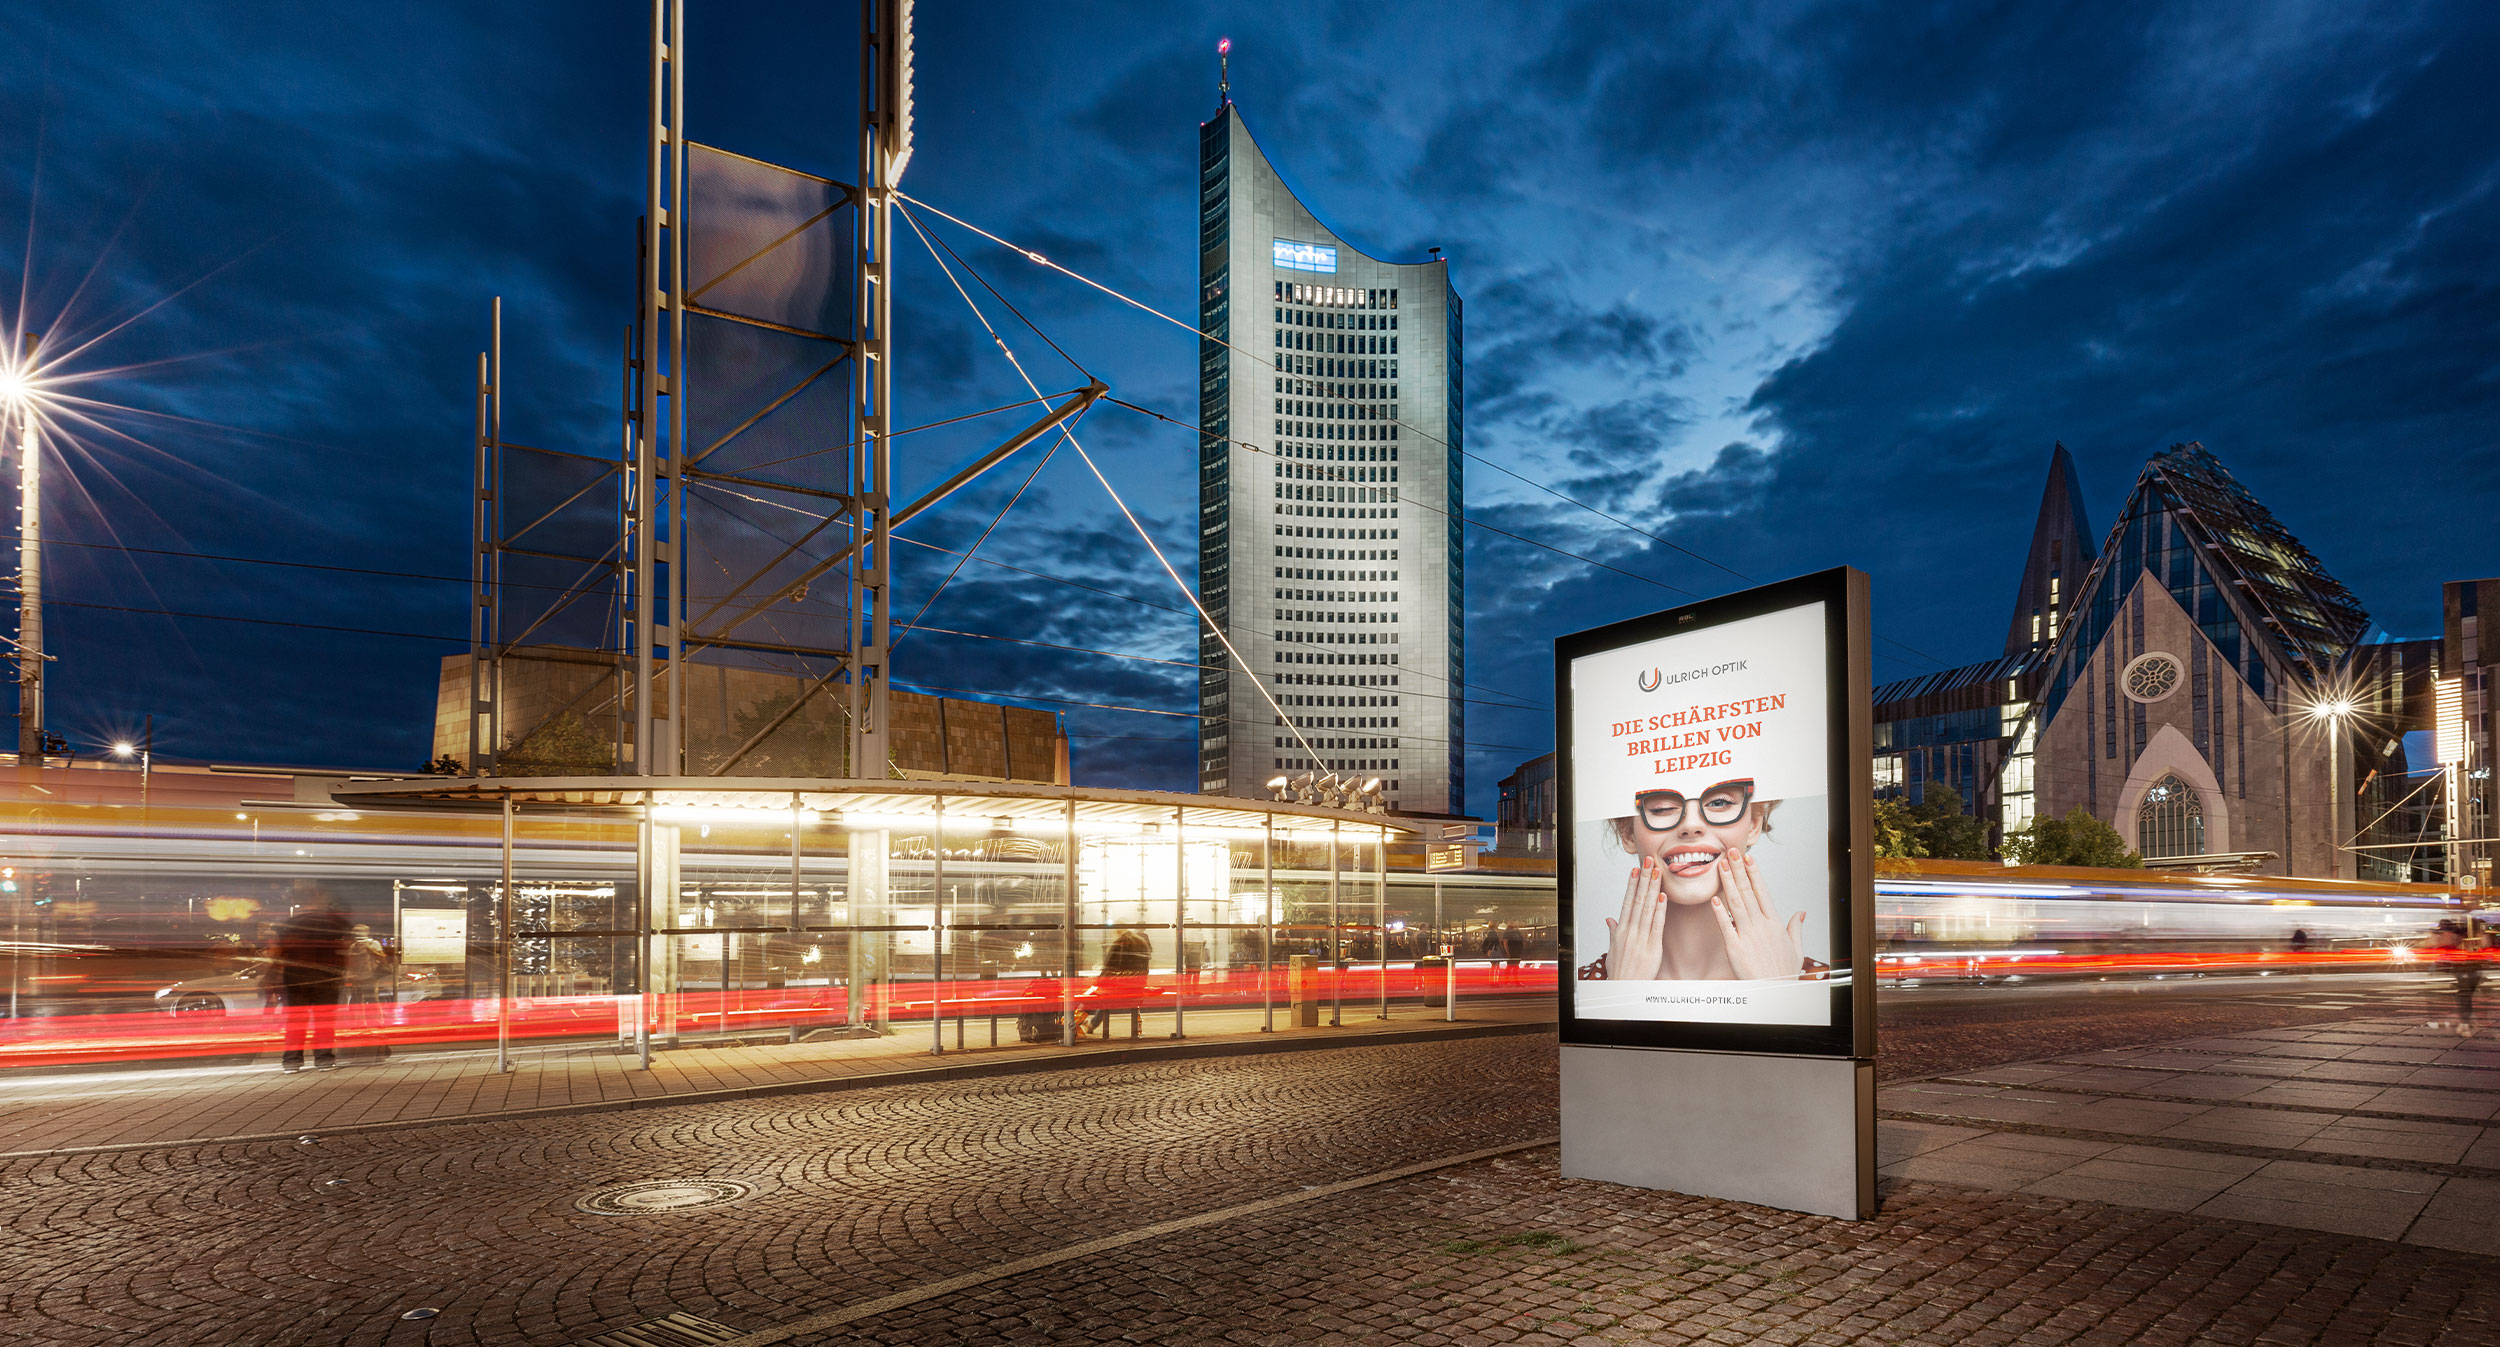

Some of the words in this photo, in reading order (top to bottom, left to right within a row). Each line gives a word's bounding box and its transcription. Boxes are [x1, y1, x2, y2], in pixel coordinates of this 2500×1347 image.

[1666, 668, 1708, 684] ULRICH
[1712, 660, 1748, 676] OPTIK
[1611, 719, 1644, 737] DIE
[1649, 693, 1787, 731] SCHÄRFSTEN
[1627, 730, 1711, 757] BRILLEN
[1717, 721, 1763, 742] VON
[1654, 750, 1732, 774] LEIPZIG
[1645, 996, 1748, 1005] WWW.ULRICH-OPTIK.DE
